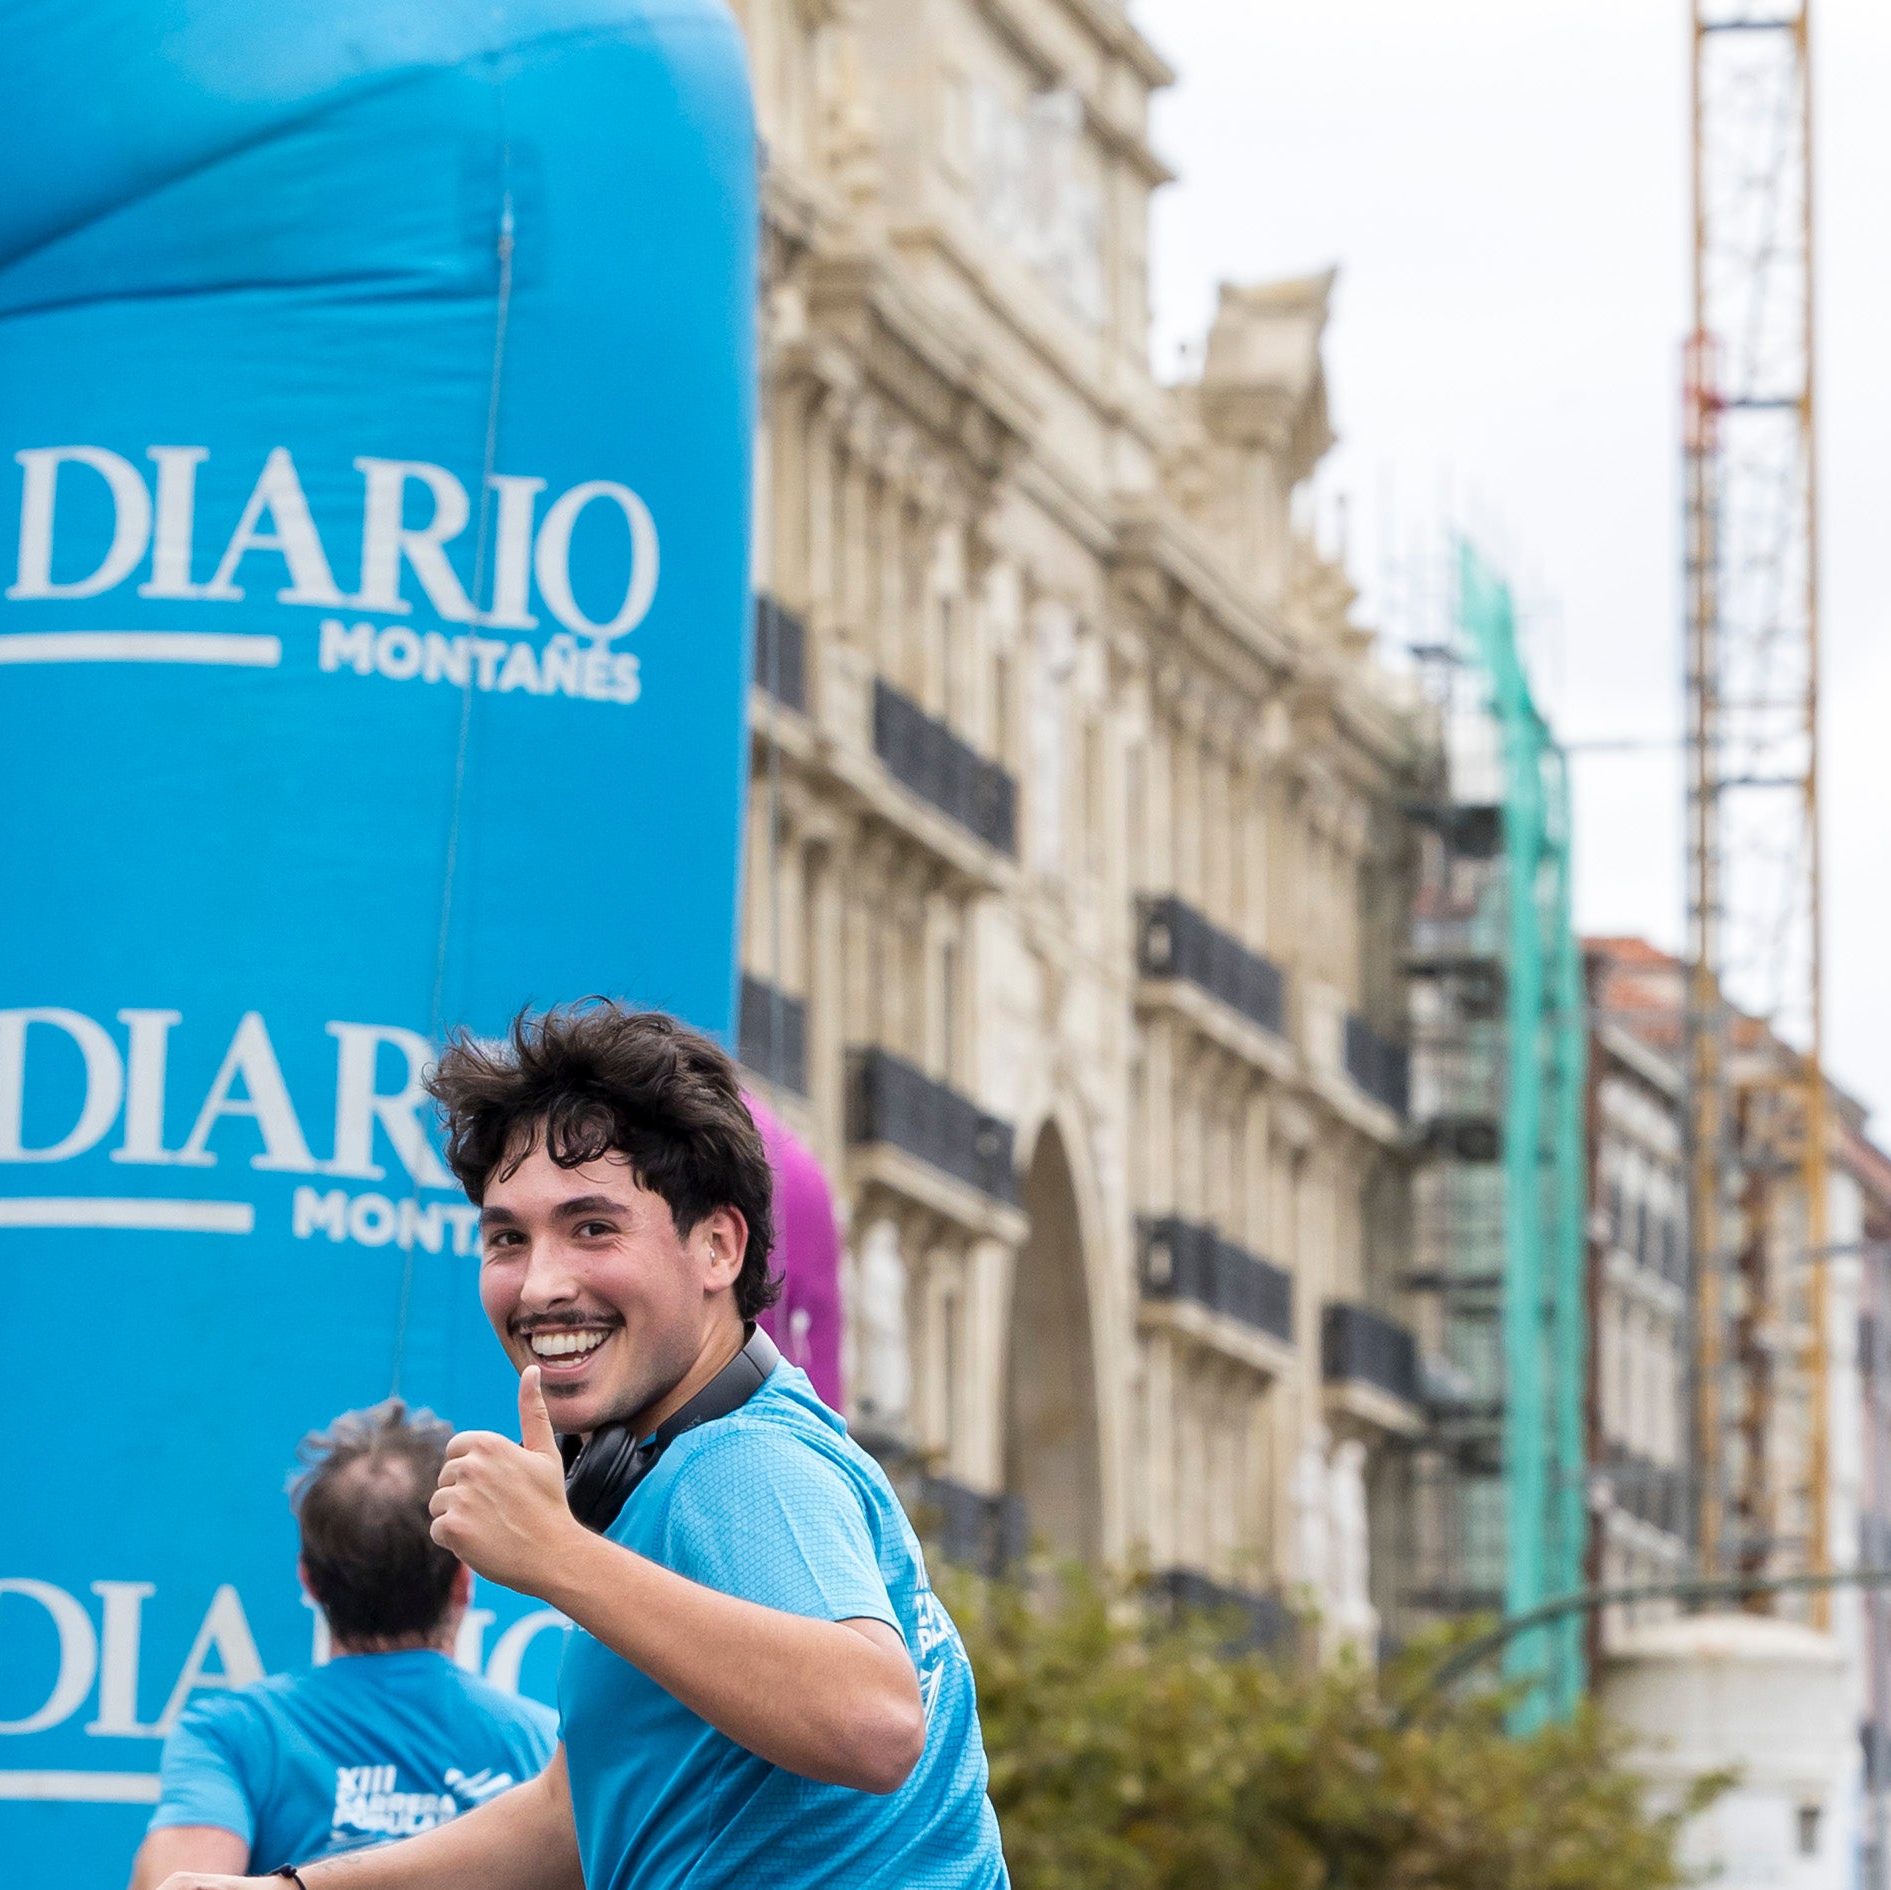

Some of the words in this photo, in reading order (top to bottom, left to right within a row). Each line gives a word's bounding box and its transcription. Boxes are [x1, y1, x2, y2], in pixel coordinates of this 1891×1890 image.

[4, 444, 661, 641] DIARIO
[318, 619, 642, 704] MONTAÑÉS
[292, 1184, 483, 1258] MONT
[336, 1763, 398, 1794] XIII
